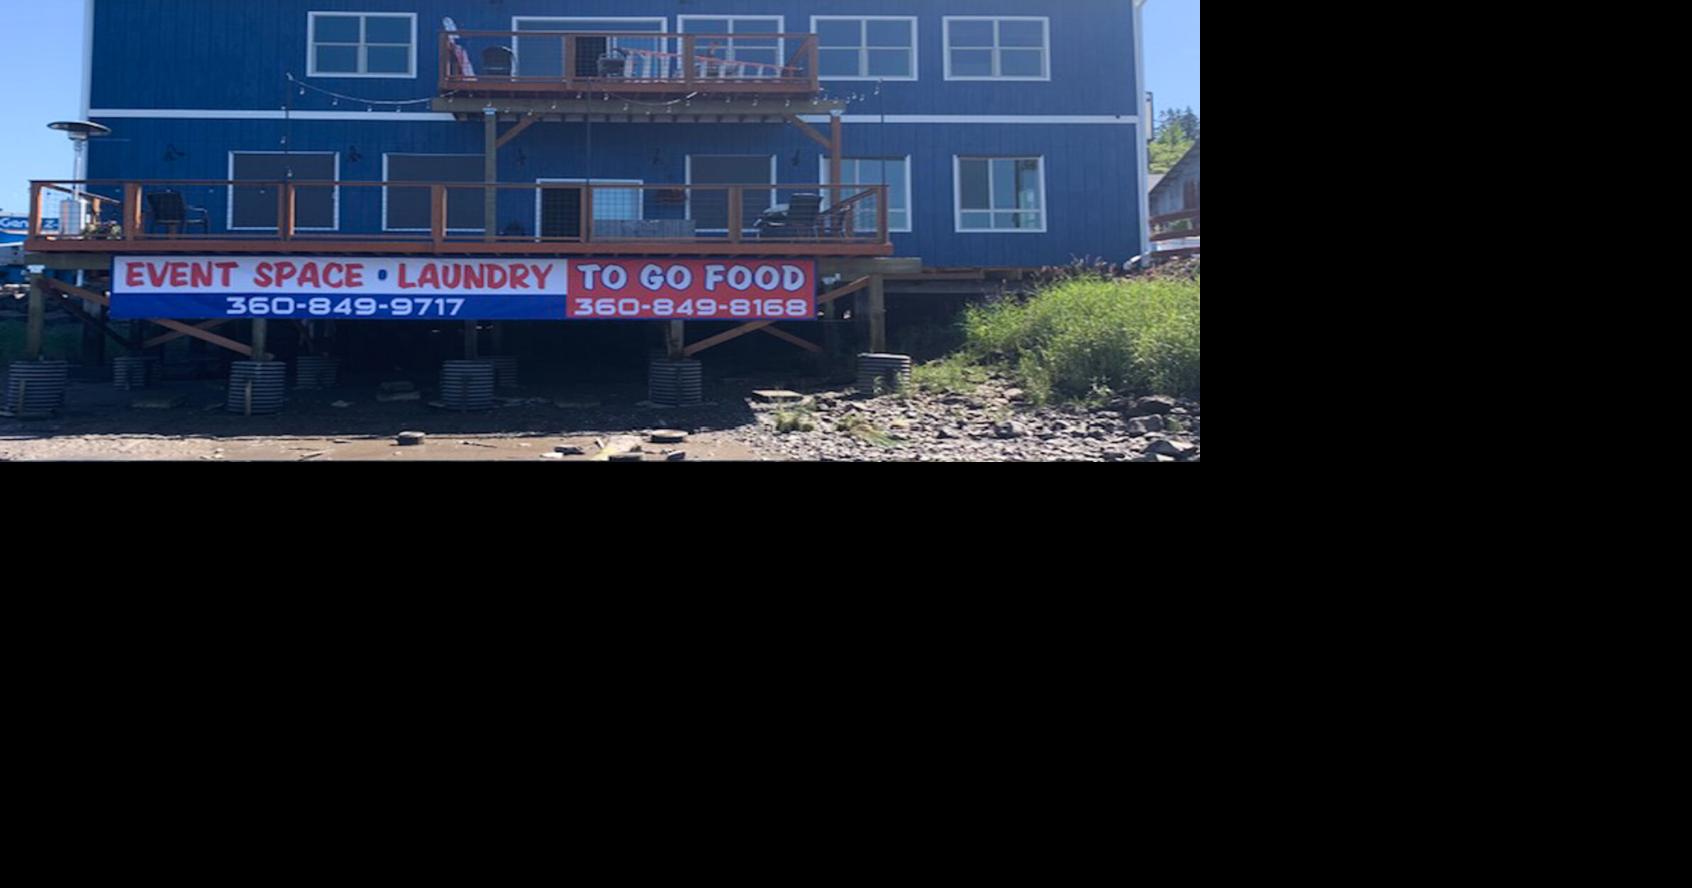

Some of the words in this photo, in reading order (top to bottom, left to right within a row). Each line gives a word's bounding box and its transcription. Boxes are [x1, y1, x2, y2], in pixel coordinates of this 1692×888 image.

[125, 261, 239, 288] EVENT
[254, 262, 364, 288] SPACE
[398, 264, 553, 290] LAUNDRY
[577, 264, 628, 290] TO
[640, 264, 692, 291] GO
[704, 264, 806, 291] FOOD
[226, 297, 465, 316] 360-849-9717
[574, 298, 807, 316] 360-849-8168
